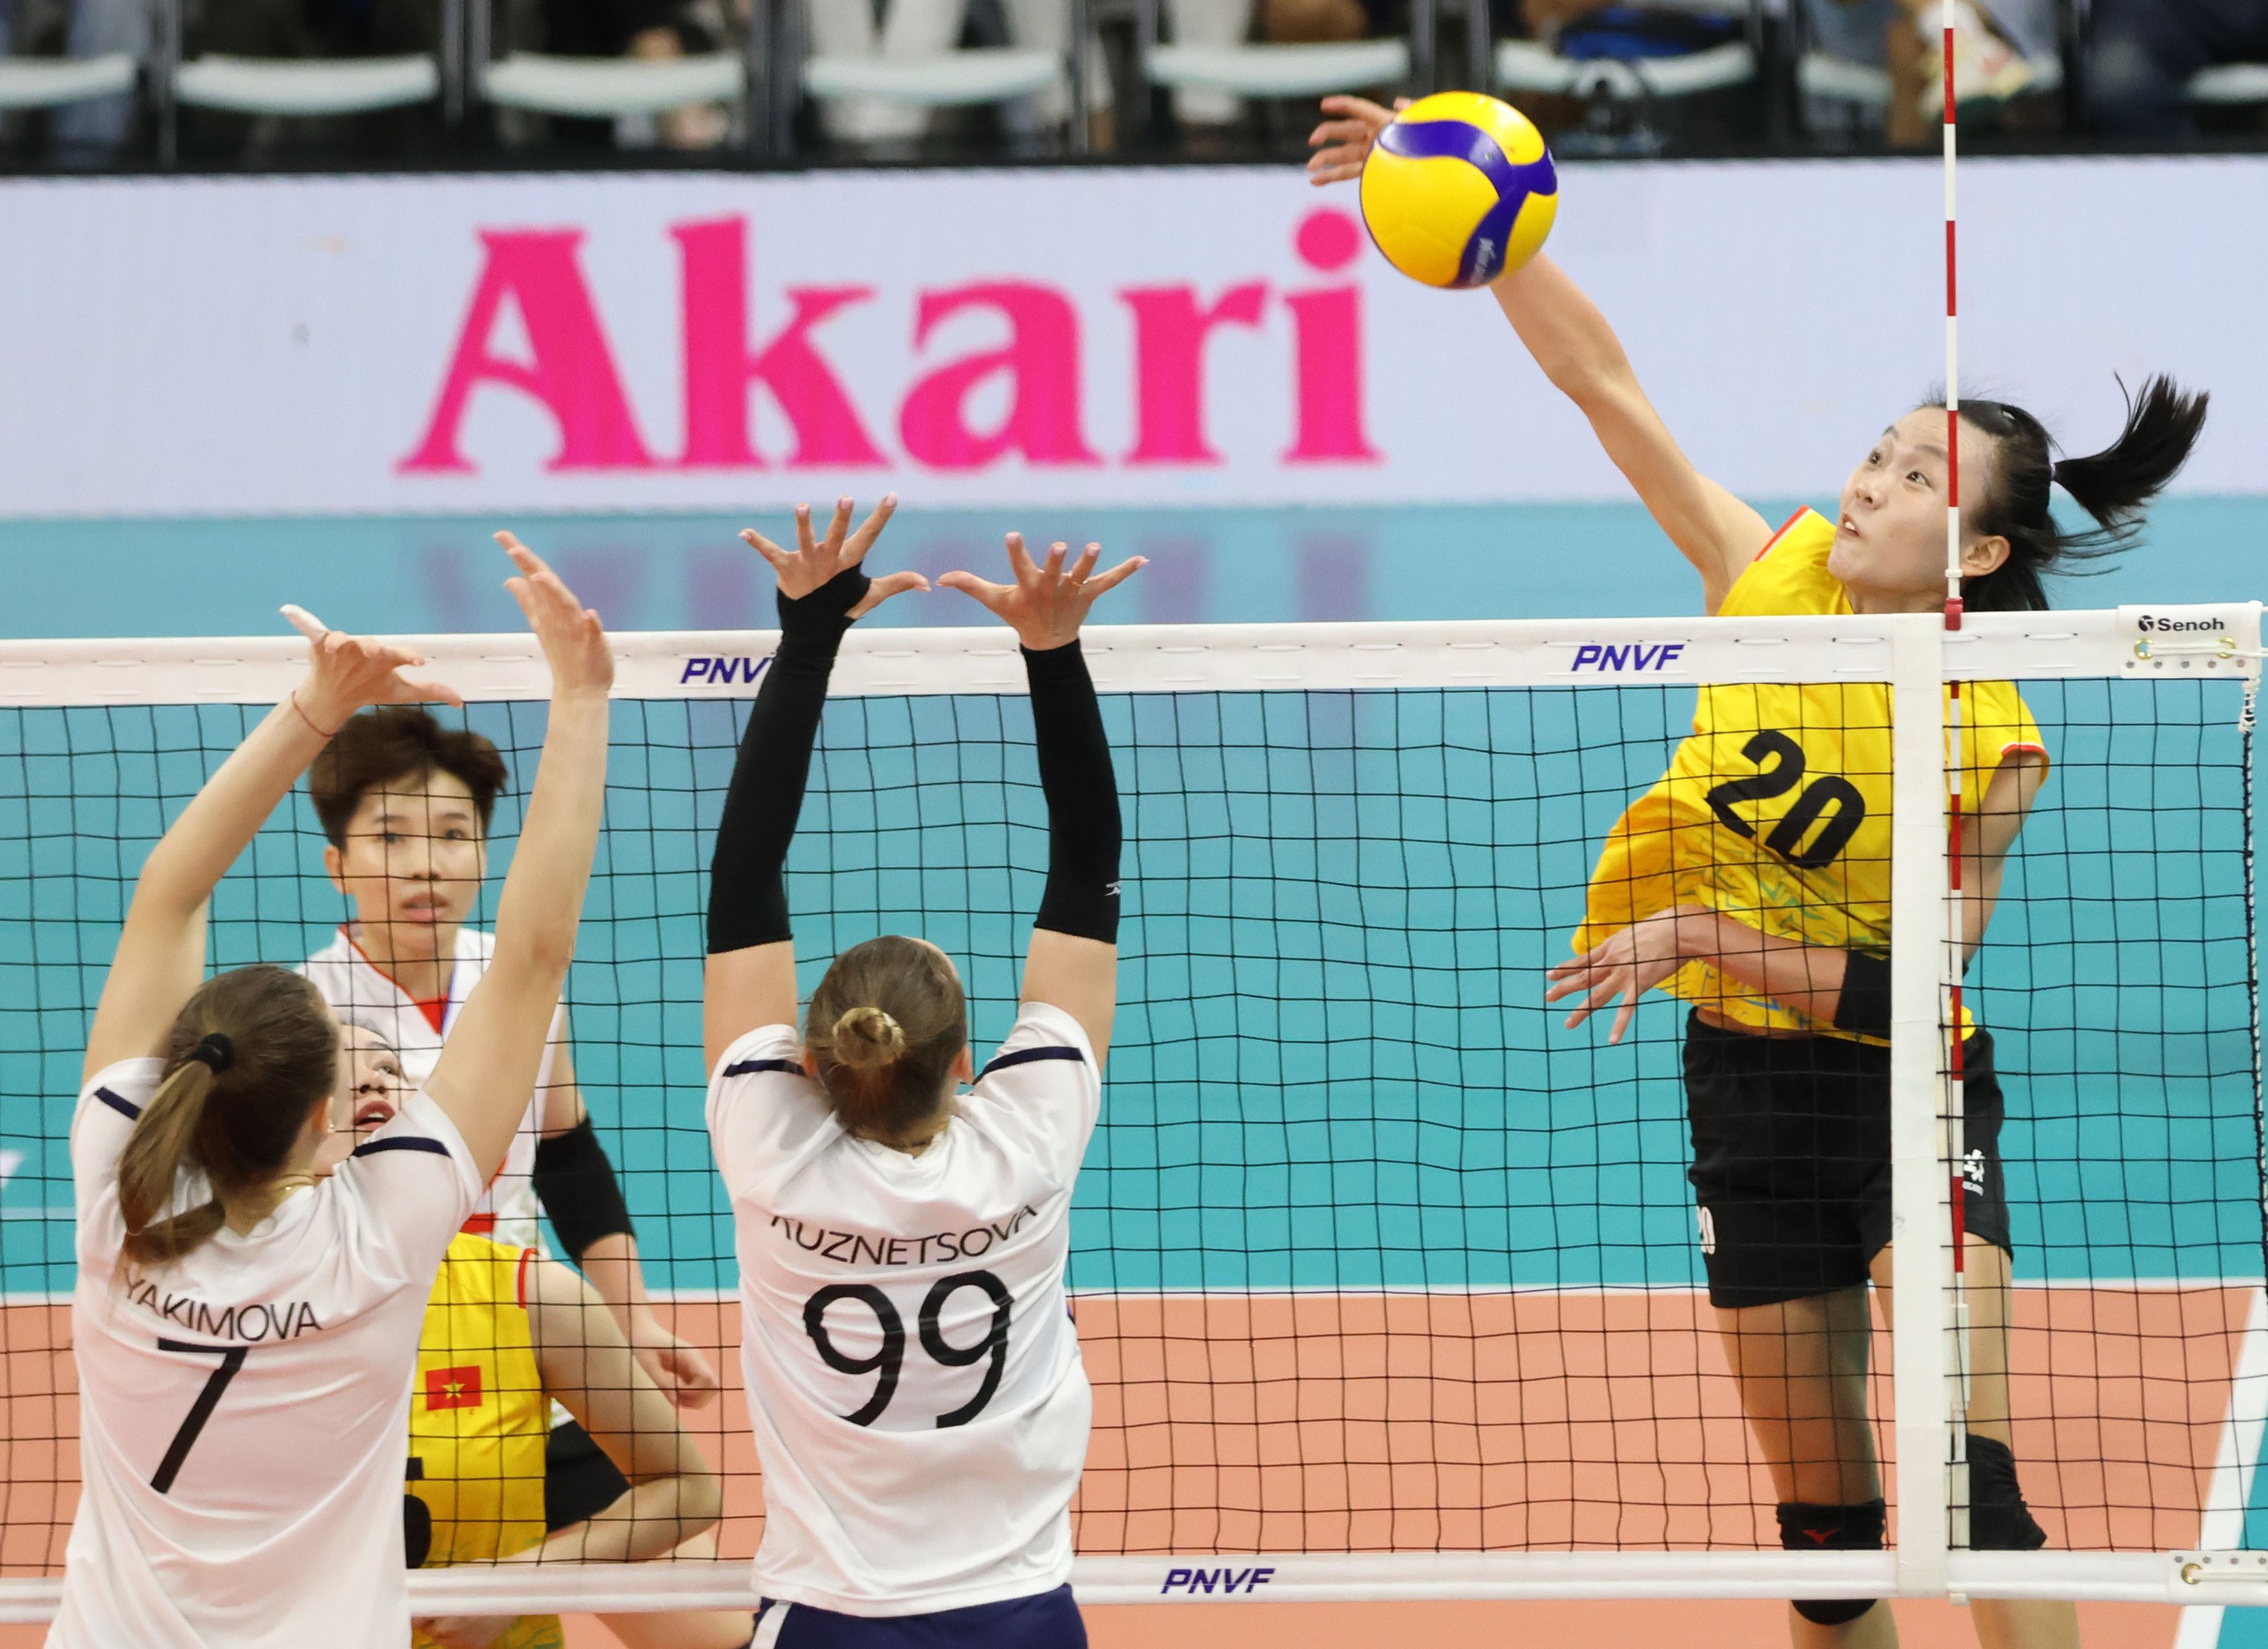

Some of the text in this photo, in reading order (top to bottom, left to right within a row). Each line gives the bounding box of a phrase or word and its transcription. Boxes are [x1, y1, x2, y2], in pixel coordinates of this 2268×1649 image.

[392, 206, 1386, 476] Akari
[1571, 644, 1685, 672] PNVF
[2156, 618, 2225, 632] Senoh
[680, 657, 772, 684] PNV
[1703, 729, 1866, 869] 20
[124, 1267, 322, 1342] YAKIMOVA
[803, 1270, 1014, 1429] 99
[150, 1336, 250, 1495] 7
[1161, 1567, 1277, 1594] PNVF
